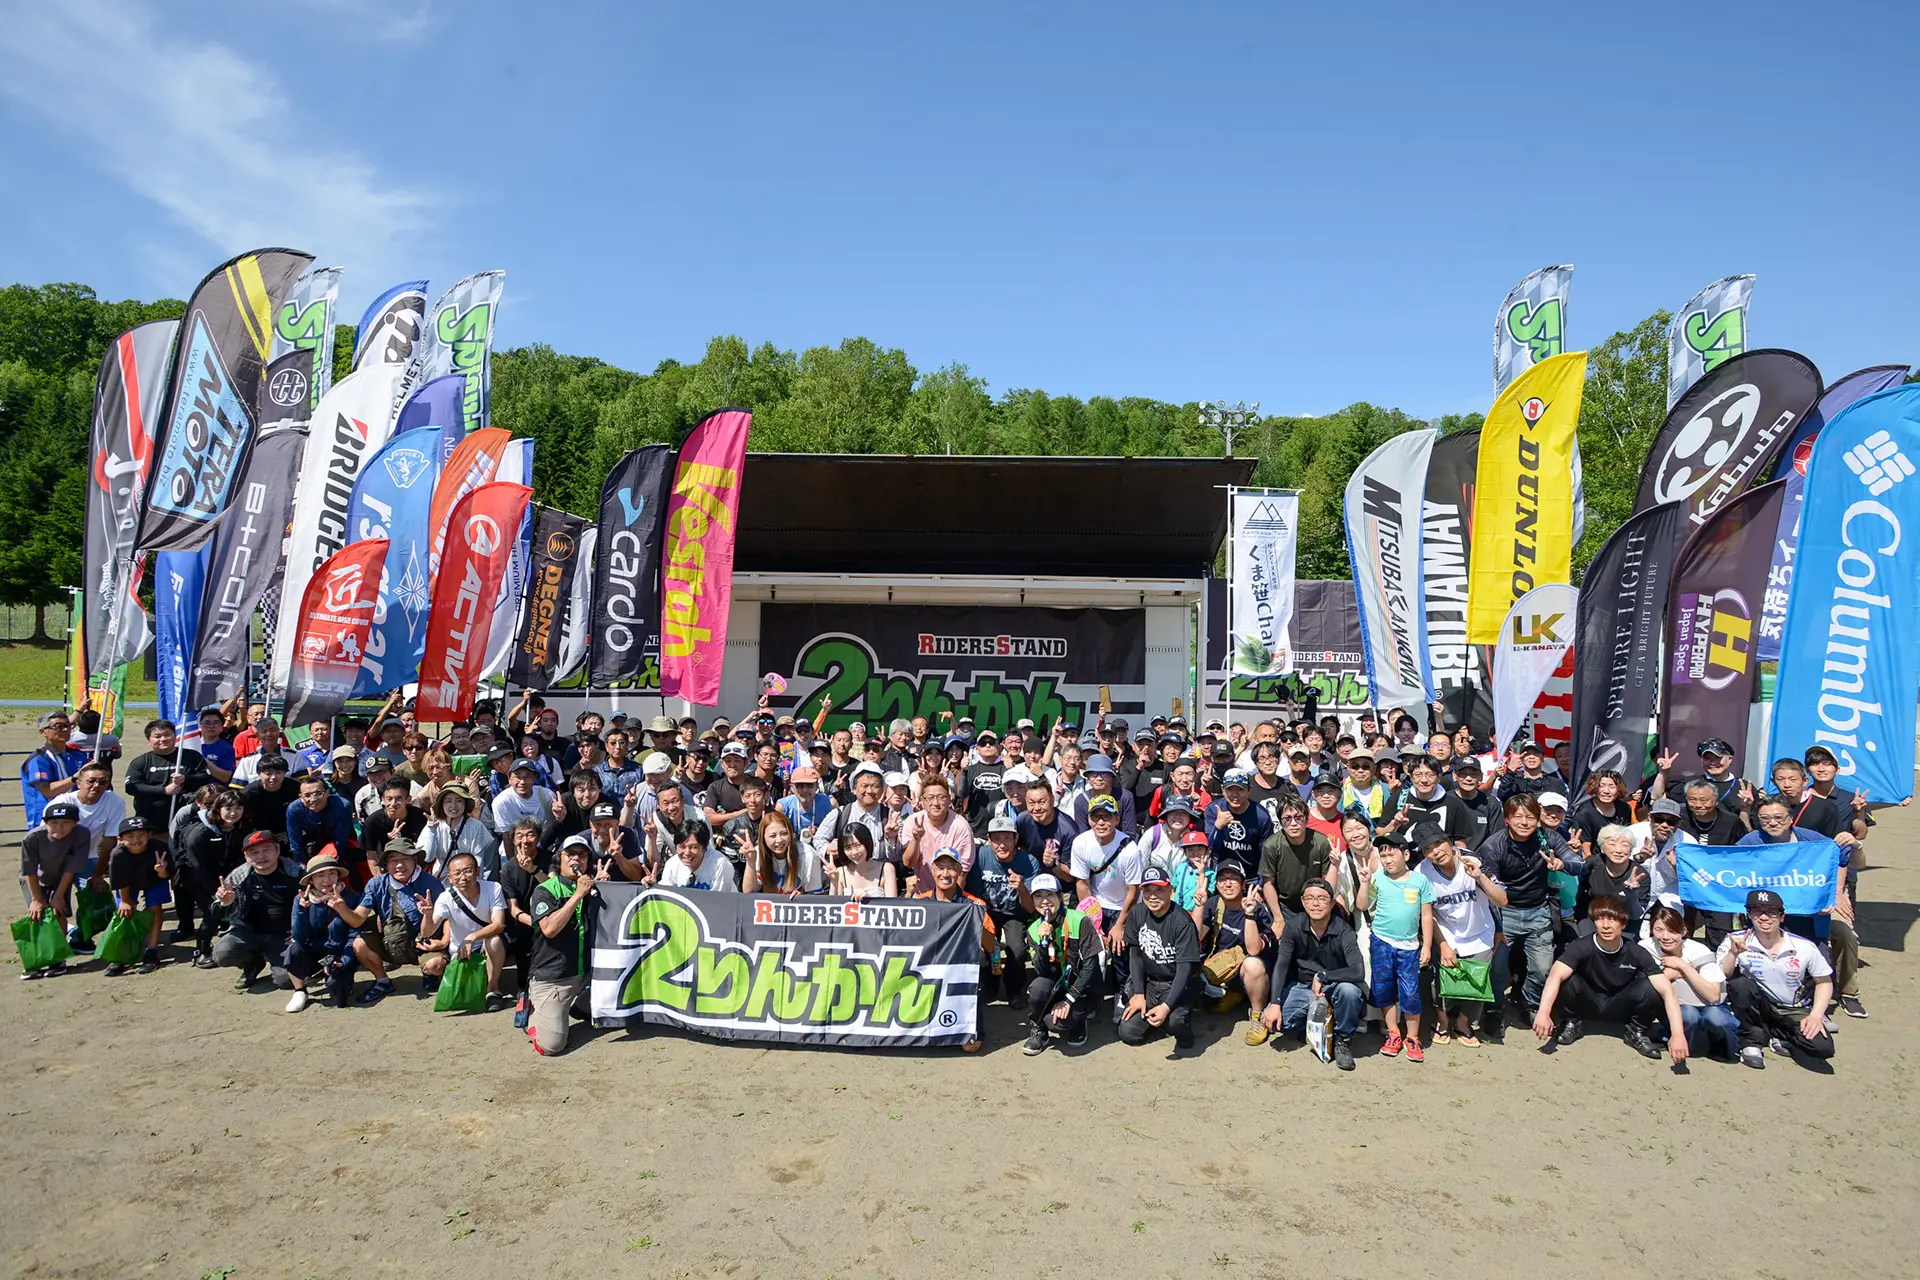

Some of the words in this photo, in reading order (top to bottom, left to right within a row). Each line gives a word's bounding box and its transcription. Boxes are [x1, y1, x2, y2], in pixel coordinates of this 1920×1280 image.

[159, 348, 199, 488] www.teramoto.biz
[171, 350, 223, 507] MOTO
[193, 405, 243, 513] TERA
[1689, 409, 1796, 526] Kabuto
[665, 460, 737, 657] Vesrah
[1510, 434, 1540, 609] DUNLO
[511, 560, 522, 613] PREMIUM
[524, 569, 544, 654] www.degner.co.jp
[532, 564, 563, 666] DEGNER
[605, 530, 645, 652] cardo
[1423, 500, 1482, 691] YAMALUBE
[1617, 532, 1647, 617] LIGHT
[1646, 561, 1658, 606] FUTURE
[438, 557, 482, 713] ACTIVE
[1606, 622, 1631, 719] SPHERE
[1638, 610, 1651, 652] BRIGHT
[1676, 644, 1690, 673] Spec
[1679, 608, 1695, 641] Japan
[1689, 592, 1713, 679] HYPERPRO
[1634, 666, 1646, 688] GET
[1223, 840, 1252, 851] YAMAHA
[1716, 869, 1827, 889] Columbia
[623, 899, 936, 1025] 2りんかん
